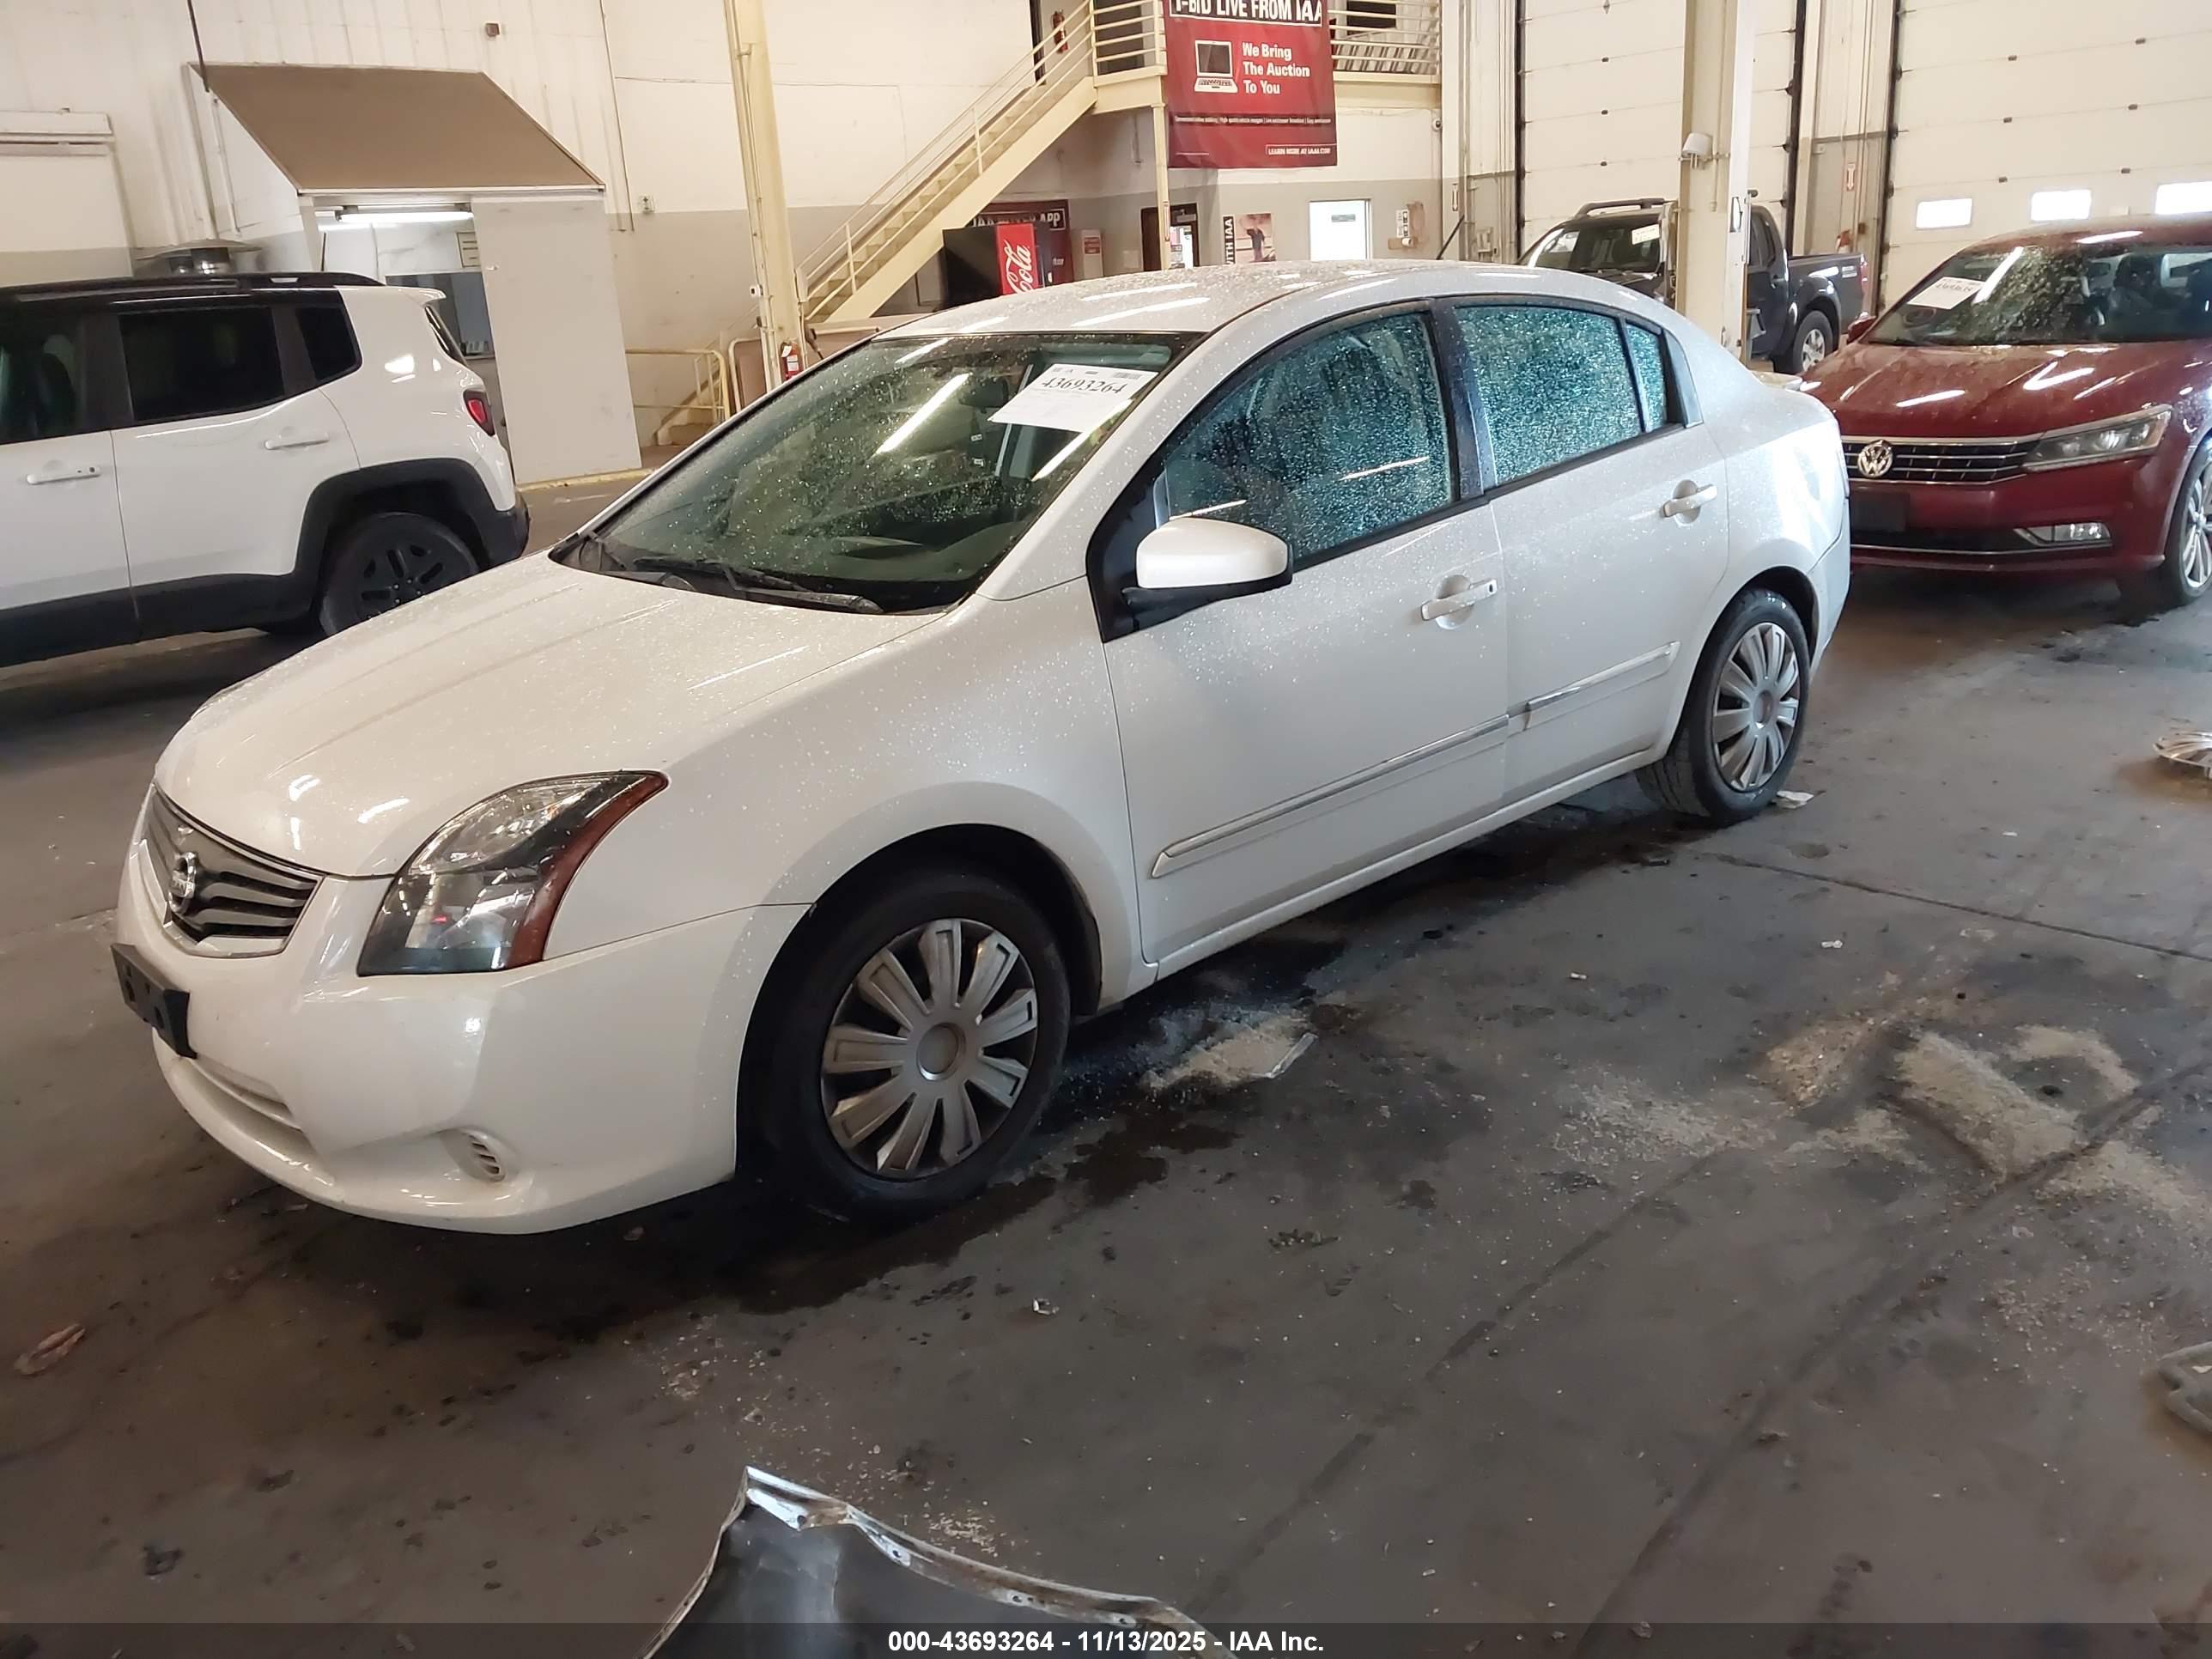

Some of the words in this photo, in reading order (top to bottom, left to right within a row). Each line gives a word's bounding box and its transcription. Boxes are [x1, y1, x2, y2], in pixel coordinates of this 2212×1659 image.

[1216, 0, 1249, 17] LIVE
[1251, 0, 1292, 20] FROM
[1242, 41, 1260, 57] We
[1261, 43, 1292, 62] Bring
[1243, 61, 1264, 76] The
[1266, 62, 1310, 77] Auction
[1243, 79, 1257, 94] To
[1260, 79, 1280, 94] You
[1224, 218, 1234, 239] IAA
[1225, 242, 1235, 265] ITH
[1042, 376, 1128, 394] 43693264
